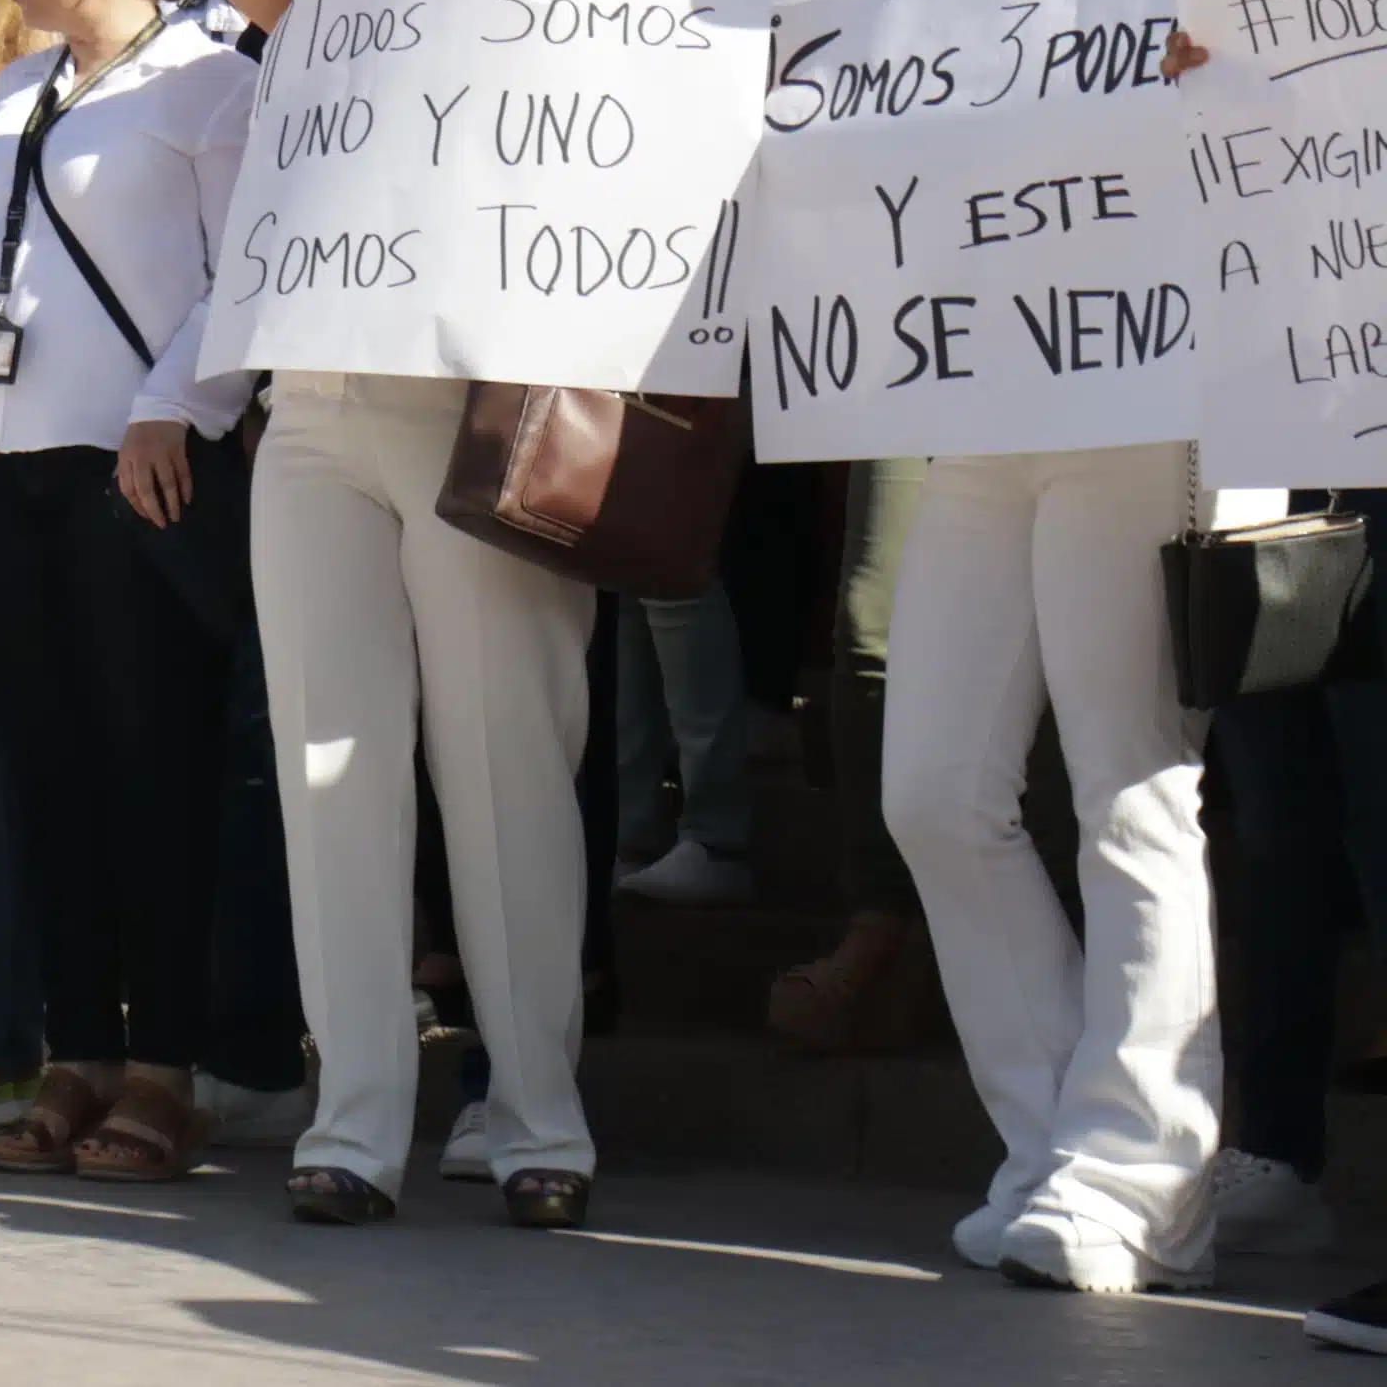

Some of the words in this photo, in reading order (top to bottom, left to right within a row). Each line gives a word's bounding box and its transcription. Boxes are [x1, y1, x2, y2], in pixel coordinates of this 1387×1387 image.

[970, 1, 1041, 107] 3
[1038, 17, 1180, 99] PODE
[277, 97, 373, 170] UNO
[424, 86, 470, 166] Y
[495, 90, 634, 168] UNO
[234, 211, 422, 305] SOMOS
[875, 174, 919, 269] Y
[960, 174, 1138, 249] ESTE
[1220, 239, 1260, 293] A
[771, 294, 859, 411] NO
[886, 295, 977, 389] SE
[1015, 283, 1195, 376] VEND
